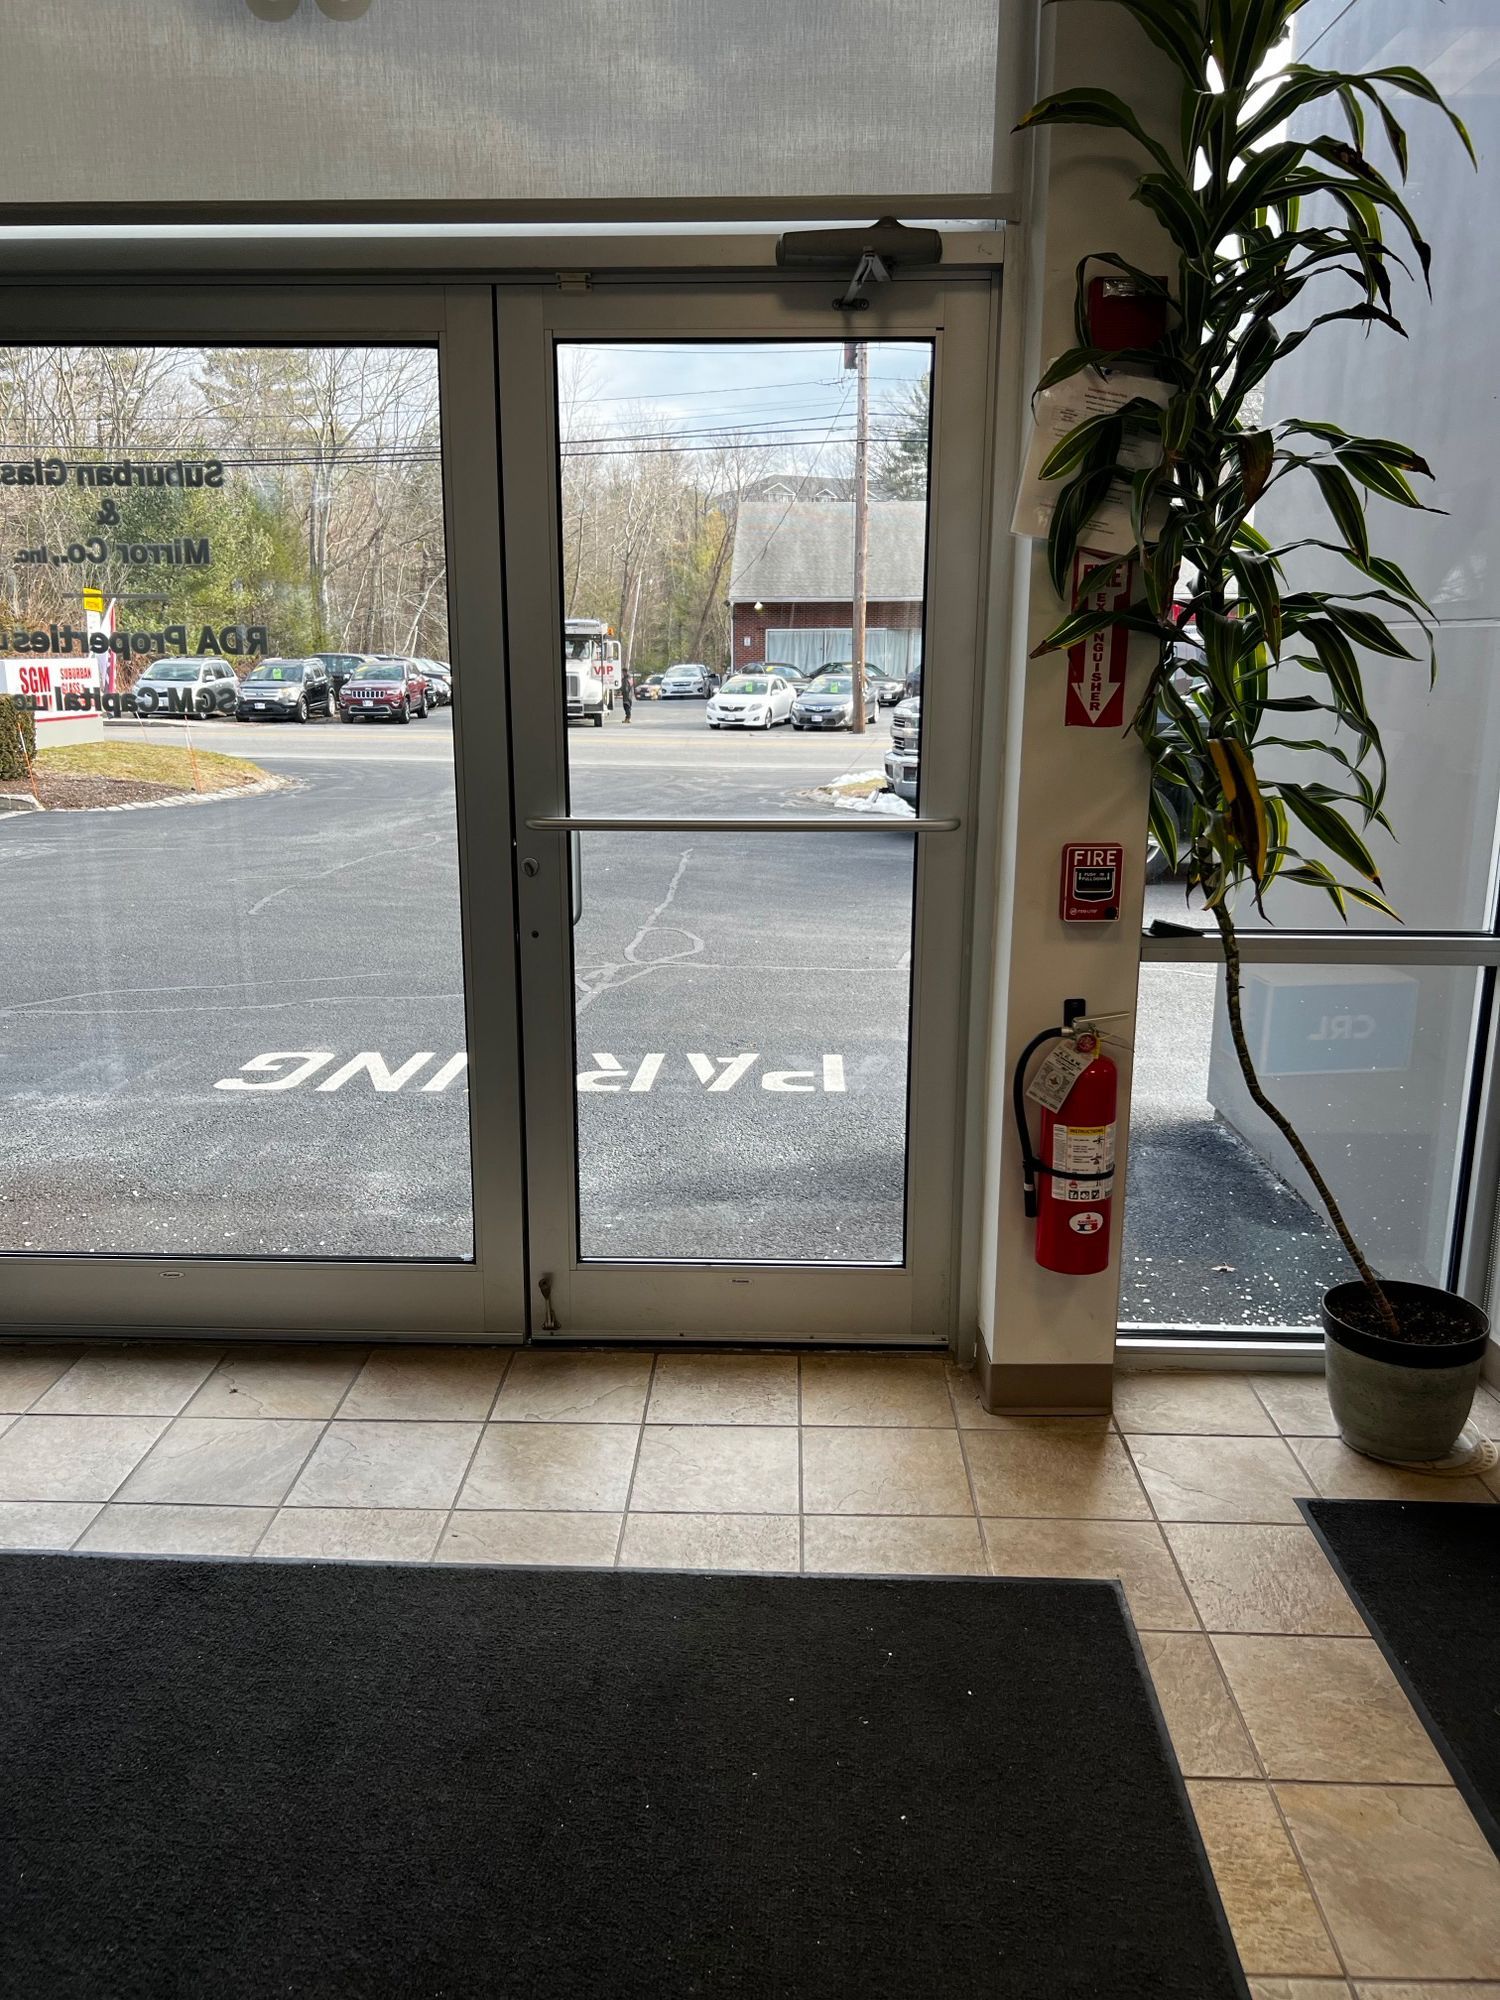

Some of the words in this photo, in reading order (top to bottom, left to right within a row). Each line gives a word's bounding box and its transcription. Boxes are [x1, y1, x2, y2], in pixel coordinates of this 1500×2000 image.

[1089, 592, 1107, 711] EXNGUISHER
[19, 666, 51, 694] SGM
[60, 667, 92, 680] SUBURBAN
[593, 665, 614, 675] VIP
[1073, 850, 1117, 866] FIRE
[213, 1051, 847, 1093] PARING
